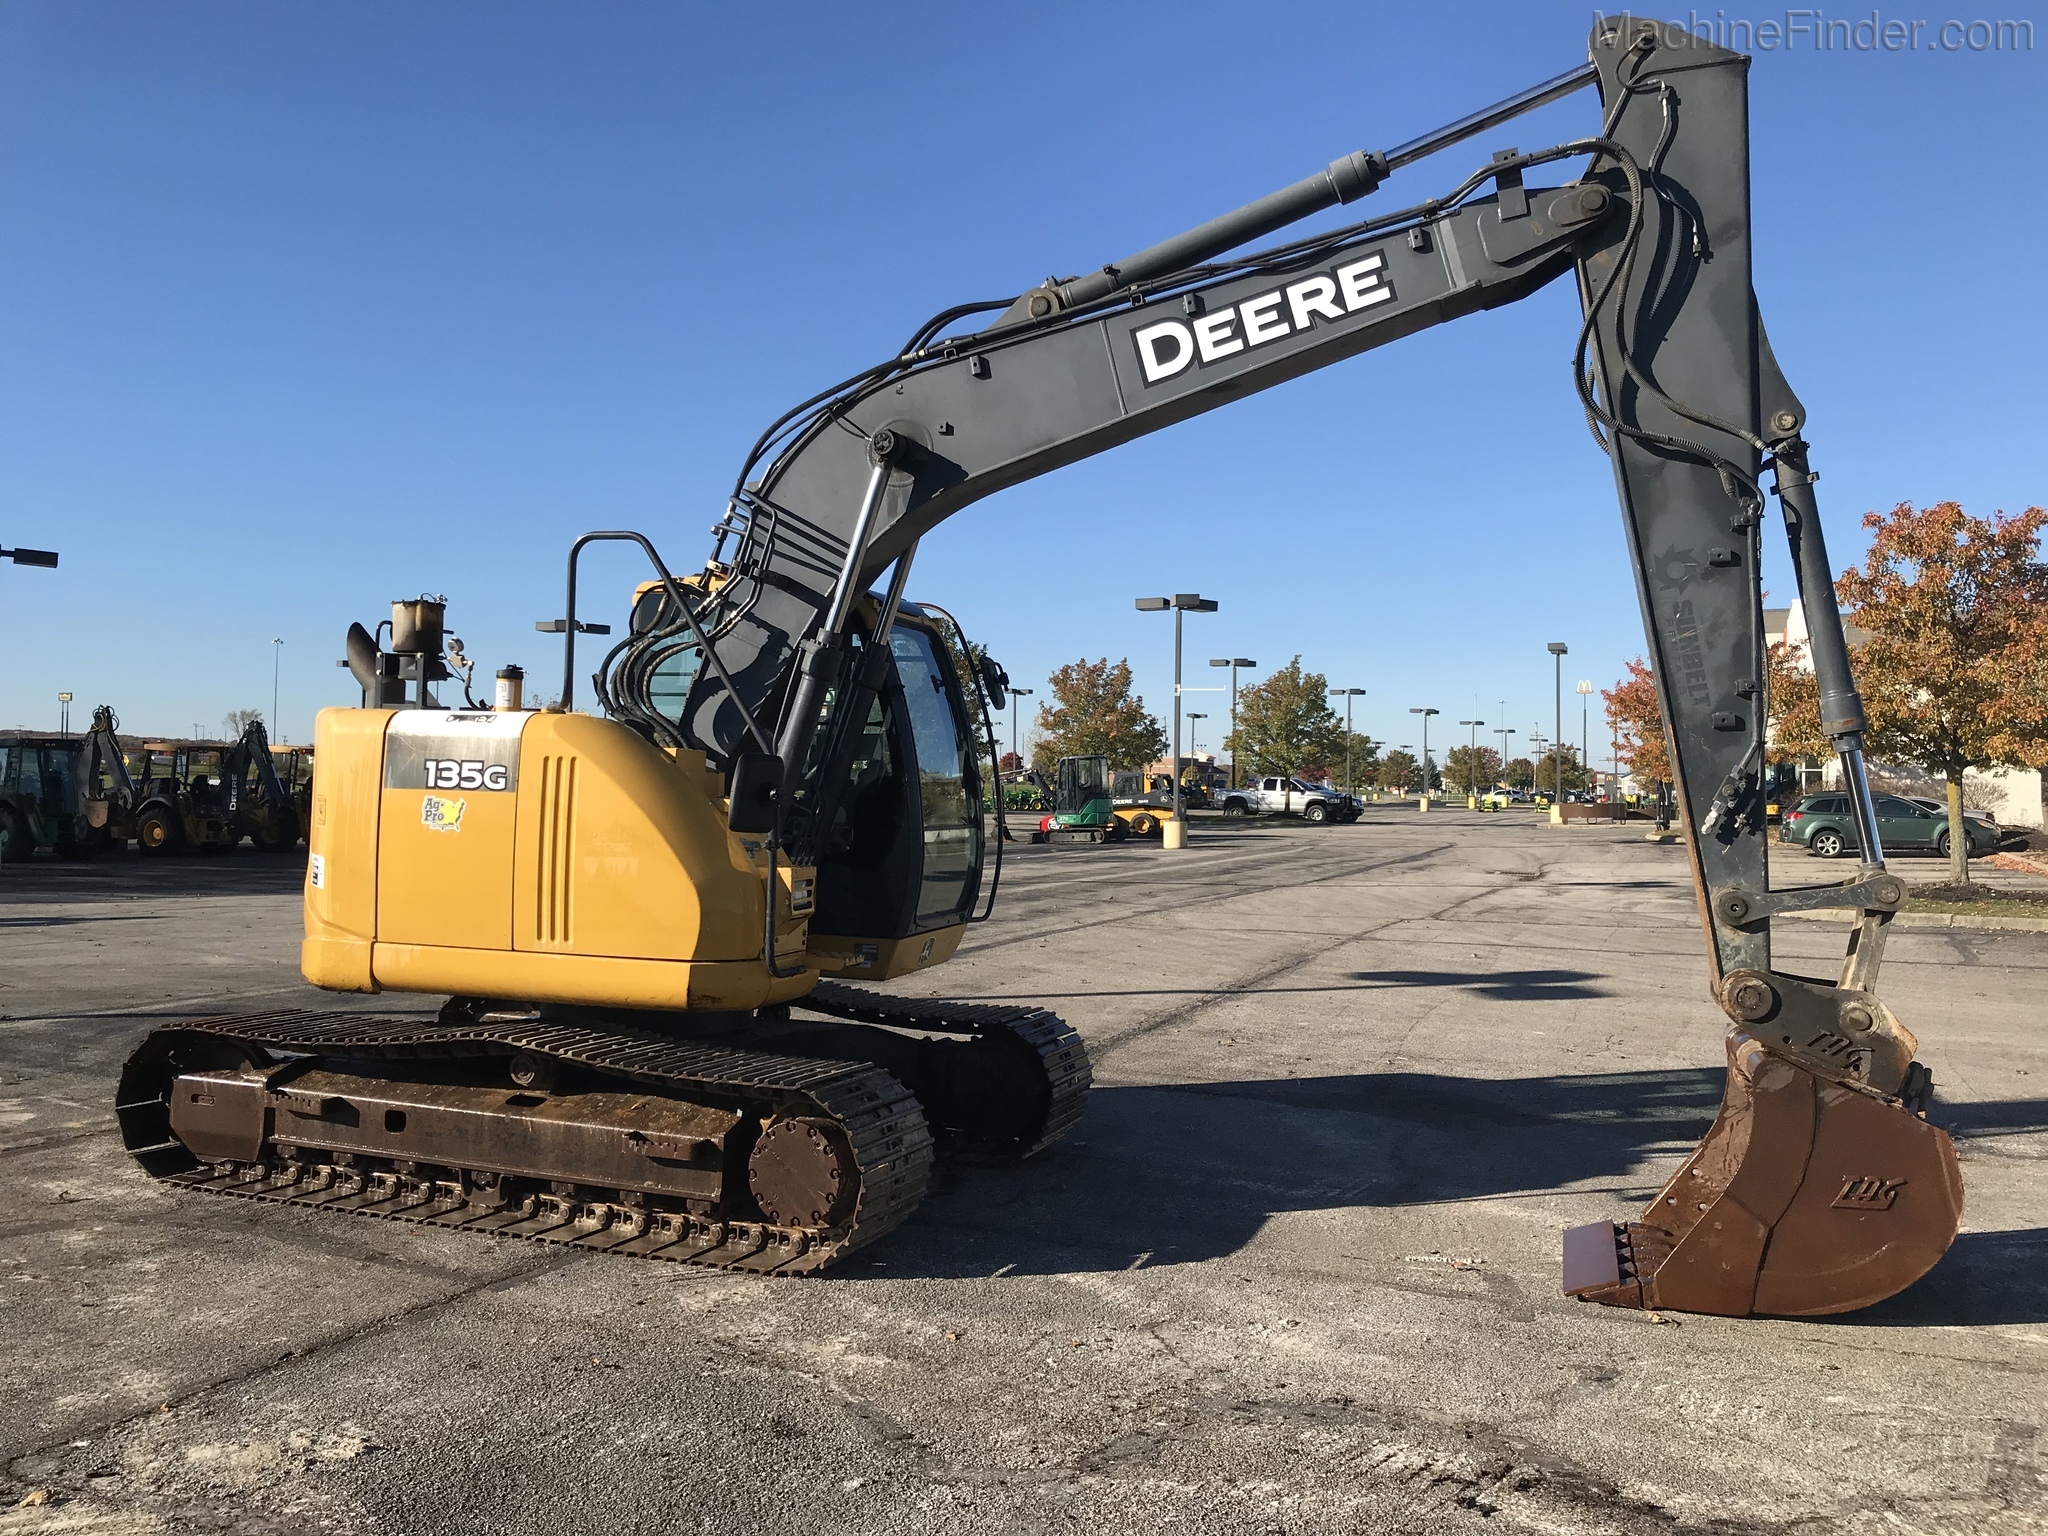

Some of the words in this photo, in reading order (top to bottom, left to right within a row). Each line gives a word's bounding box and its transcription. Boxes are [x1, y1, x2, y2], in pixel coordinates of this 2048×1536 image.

[1133, 252, 1394, 385] DEERE
[1672, 599, 1712, 708] SUNBELT
[229, 773, 238, 811] DEERE
[424, 758, 508, 791] 135G
[424, 798, 445, 812] Ag-
[424, 810, 444, 821] Pro
